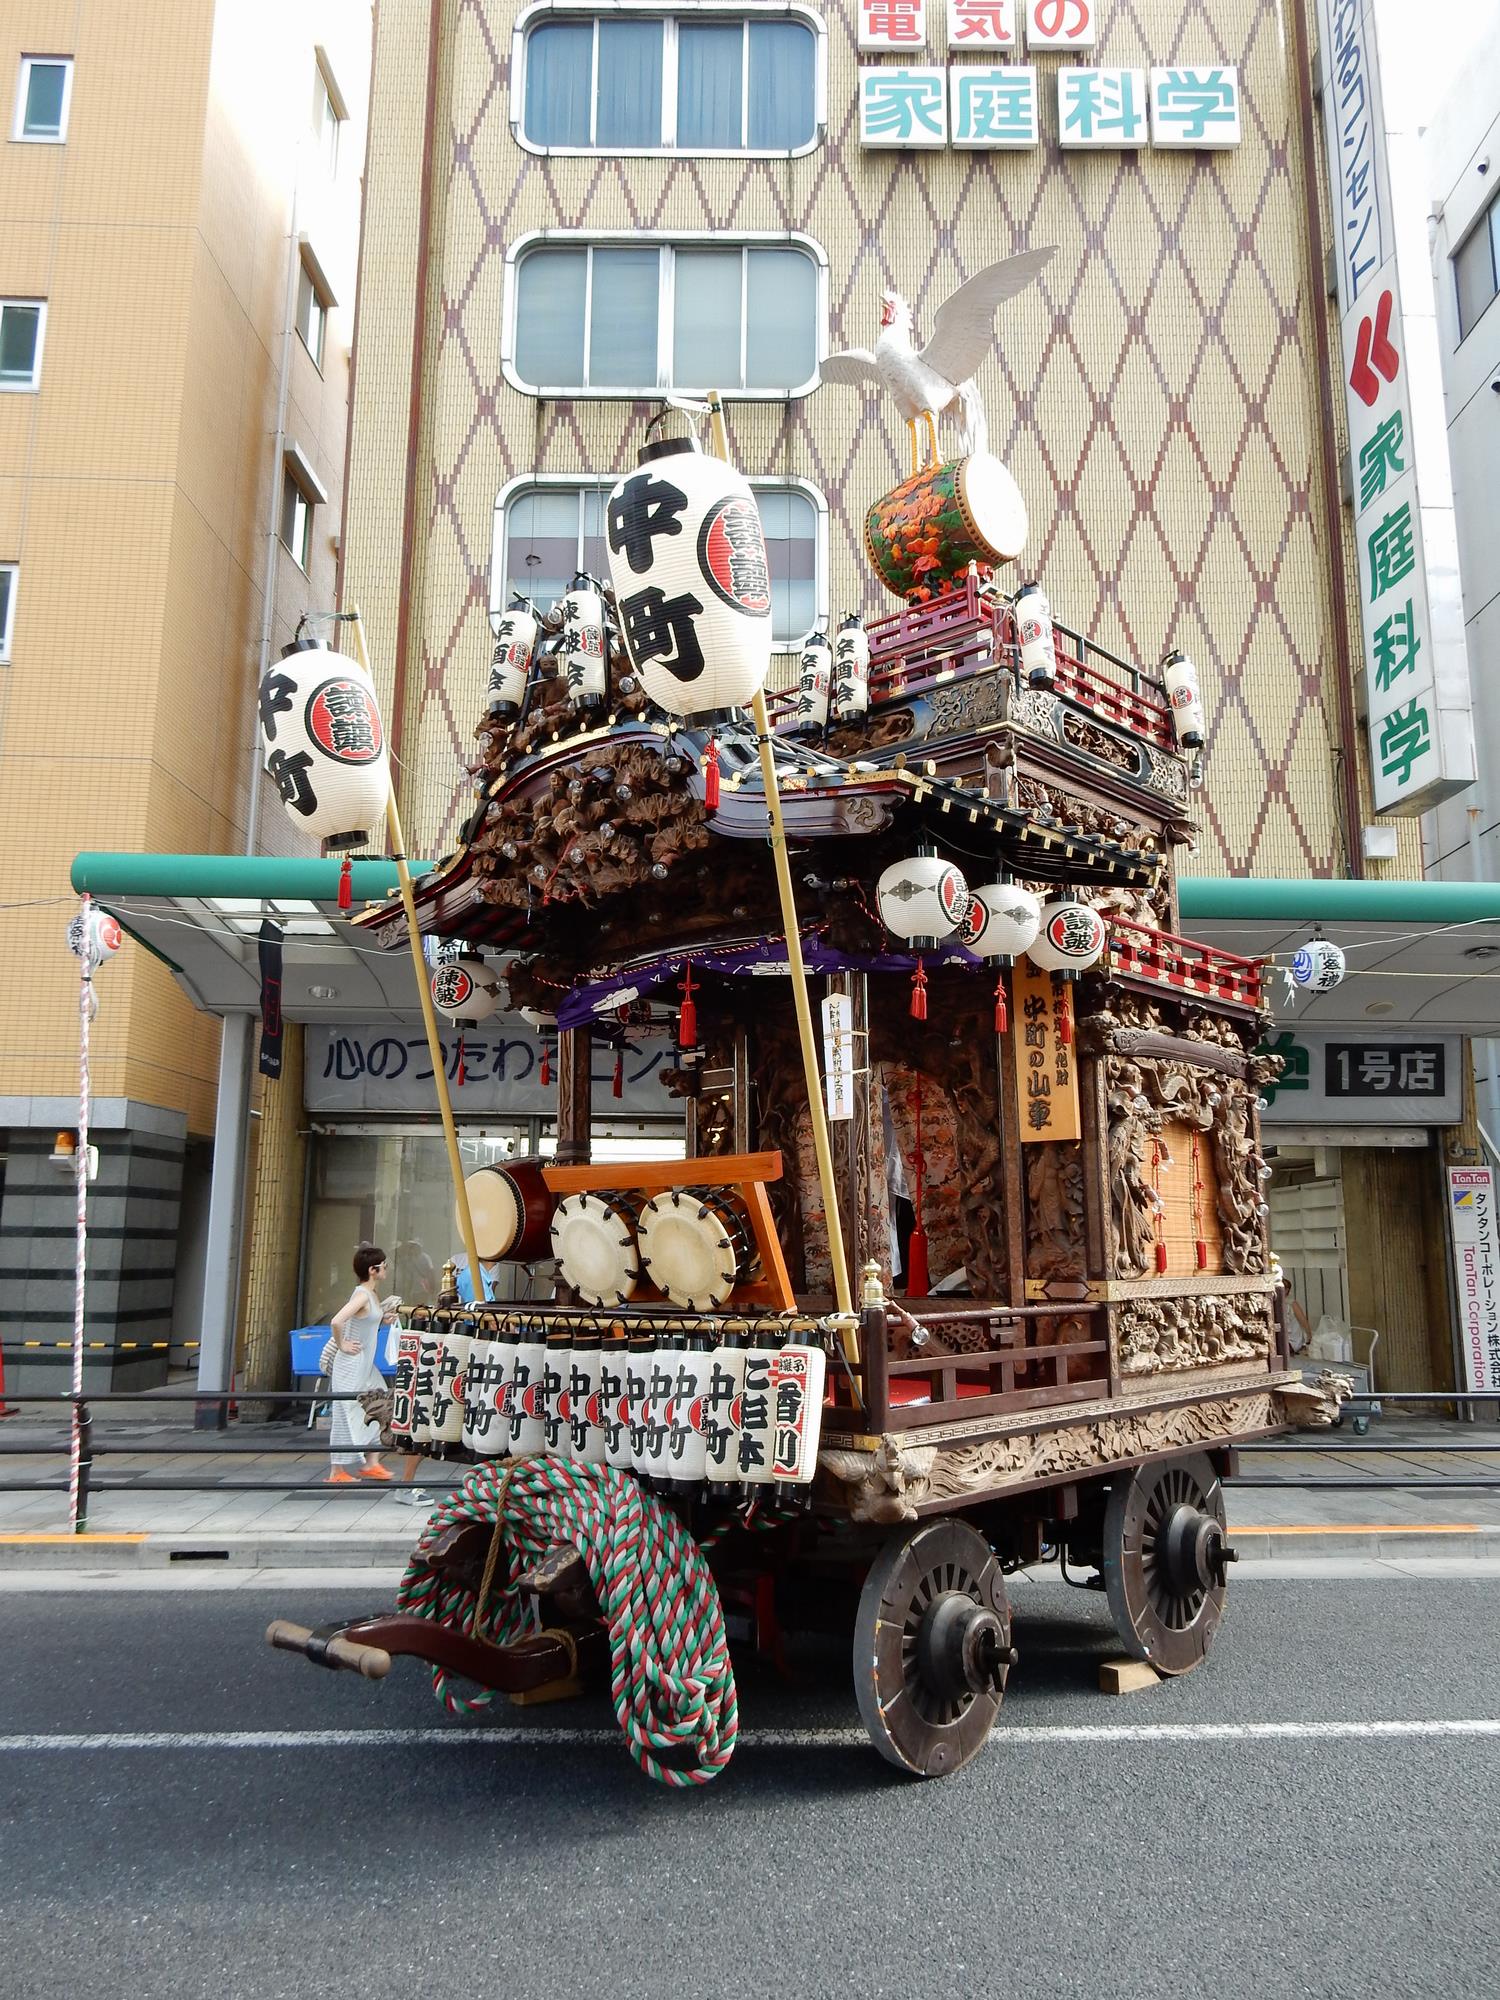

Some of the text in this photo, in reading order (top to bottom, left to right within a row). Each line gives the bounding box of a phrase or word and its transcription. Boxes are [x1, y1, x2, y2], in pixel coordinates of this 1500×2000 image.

[864, 0, 1090, 41] 電気の
[865, 71, 1235, 138] 家庭科学
[1332, 0, 1376, 296] わるコンセント
[608, 473, 704, 682] 中町
[1358, 409, 1432, 787] 家庭科学
[259, 668, 318, 817] 中町
[1024, 995, 1052, 1131] 中町の山車
[1337, 1050, 1437, 1090] 1号店
[1453, 1173, 1489, 1183] TanTan
[1463, 1245, 1486, 1389] TanTan Corporation
[1475, 1192, 1500, 1389] タンタンコーポレーション株式会社
[706, 1362, 736, 1465] 中町
